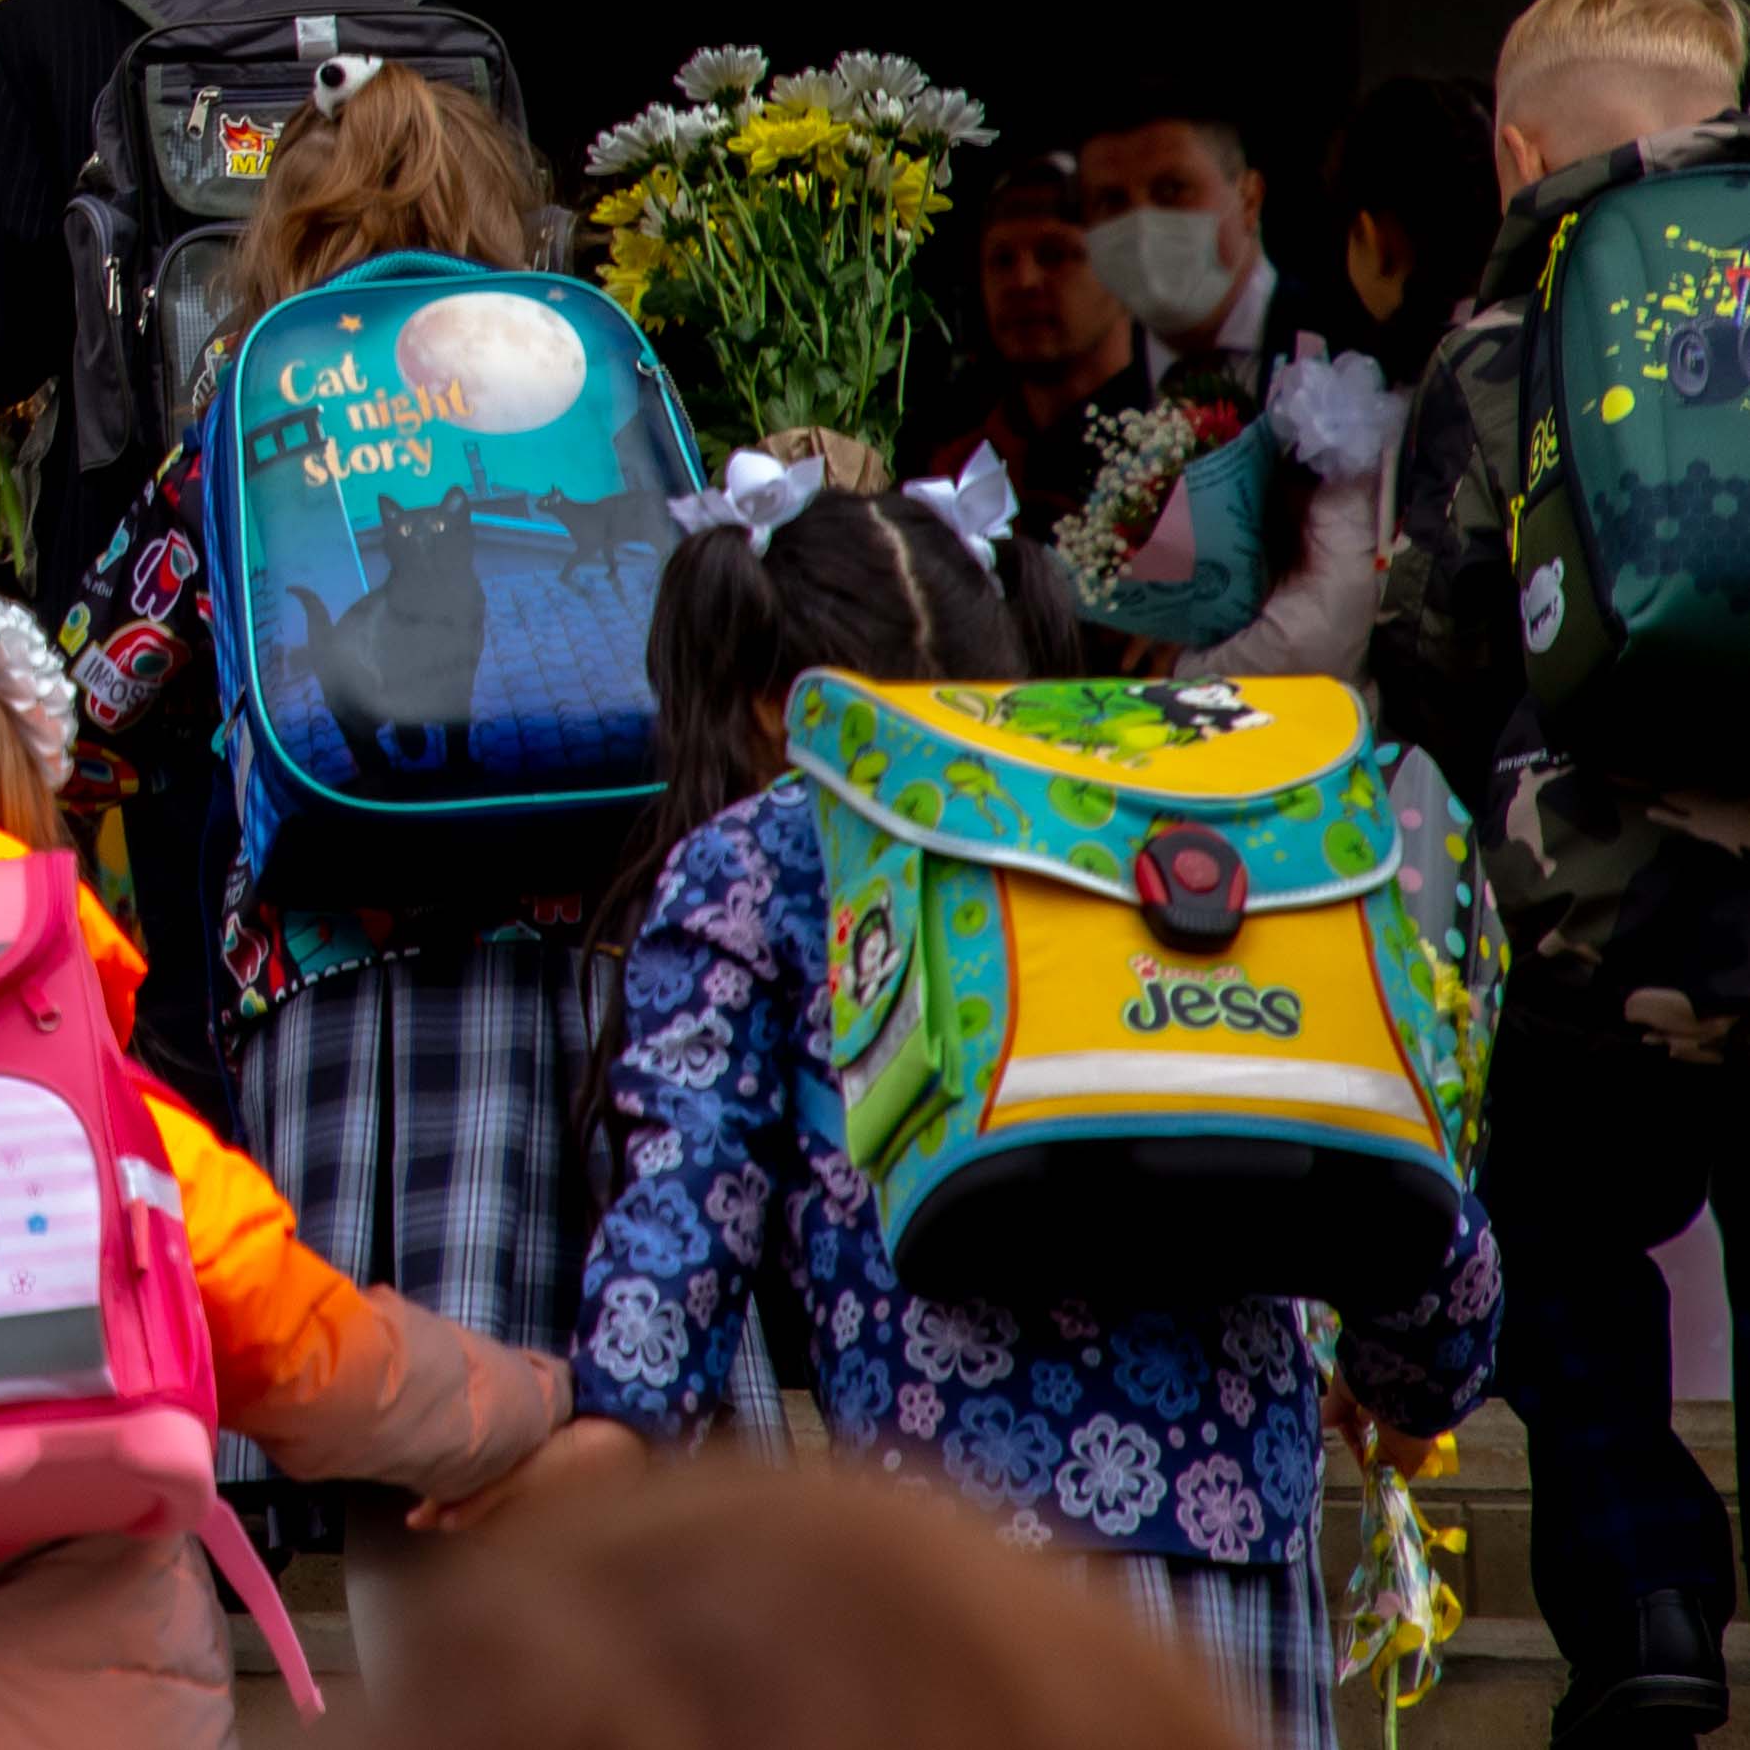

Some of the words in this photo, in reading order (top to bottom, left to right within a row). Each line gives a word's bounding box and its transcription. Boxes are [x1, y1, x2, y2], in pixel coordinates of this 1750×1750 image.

[279, 351, 369, 406] Cat
[345, 377, 476, 436] night
[303, 436, 433, 488] story
